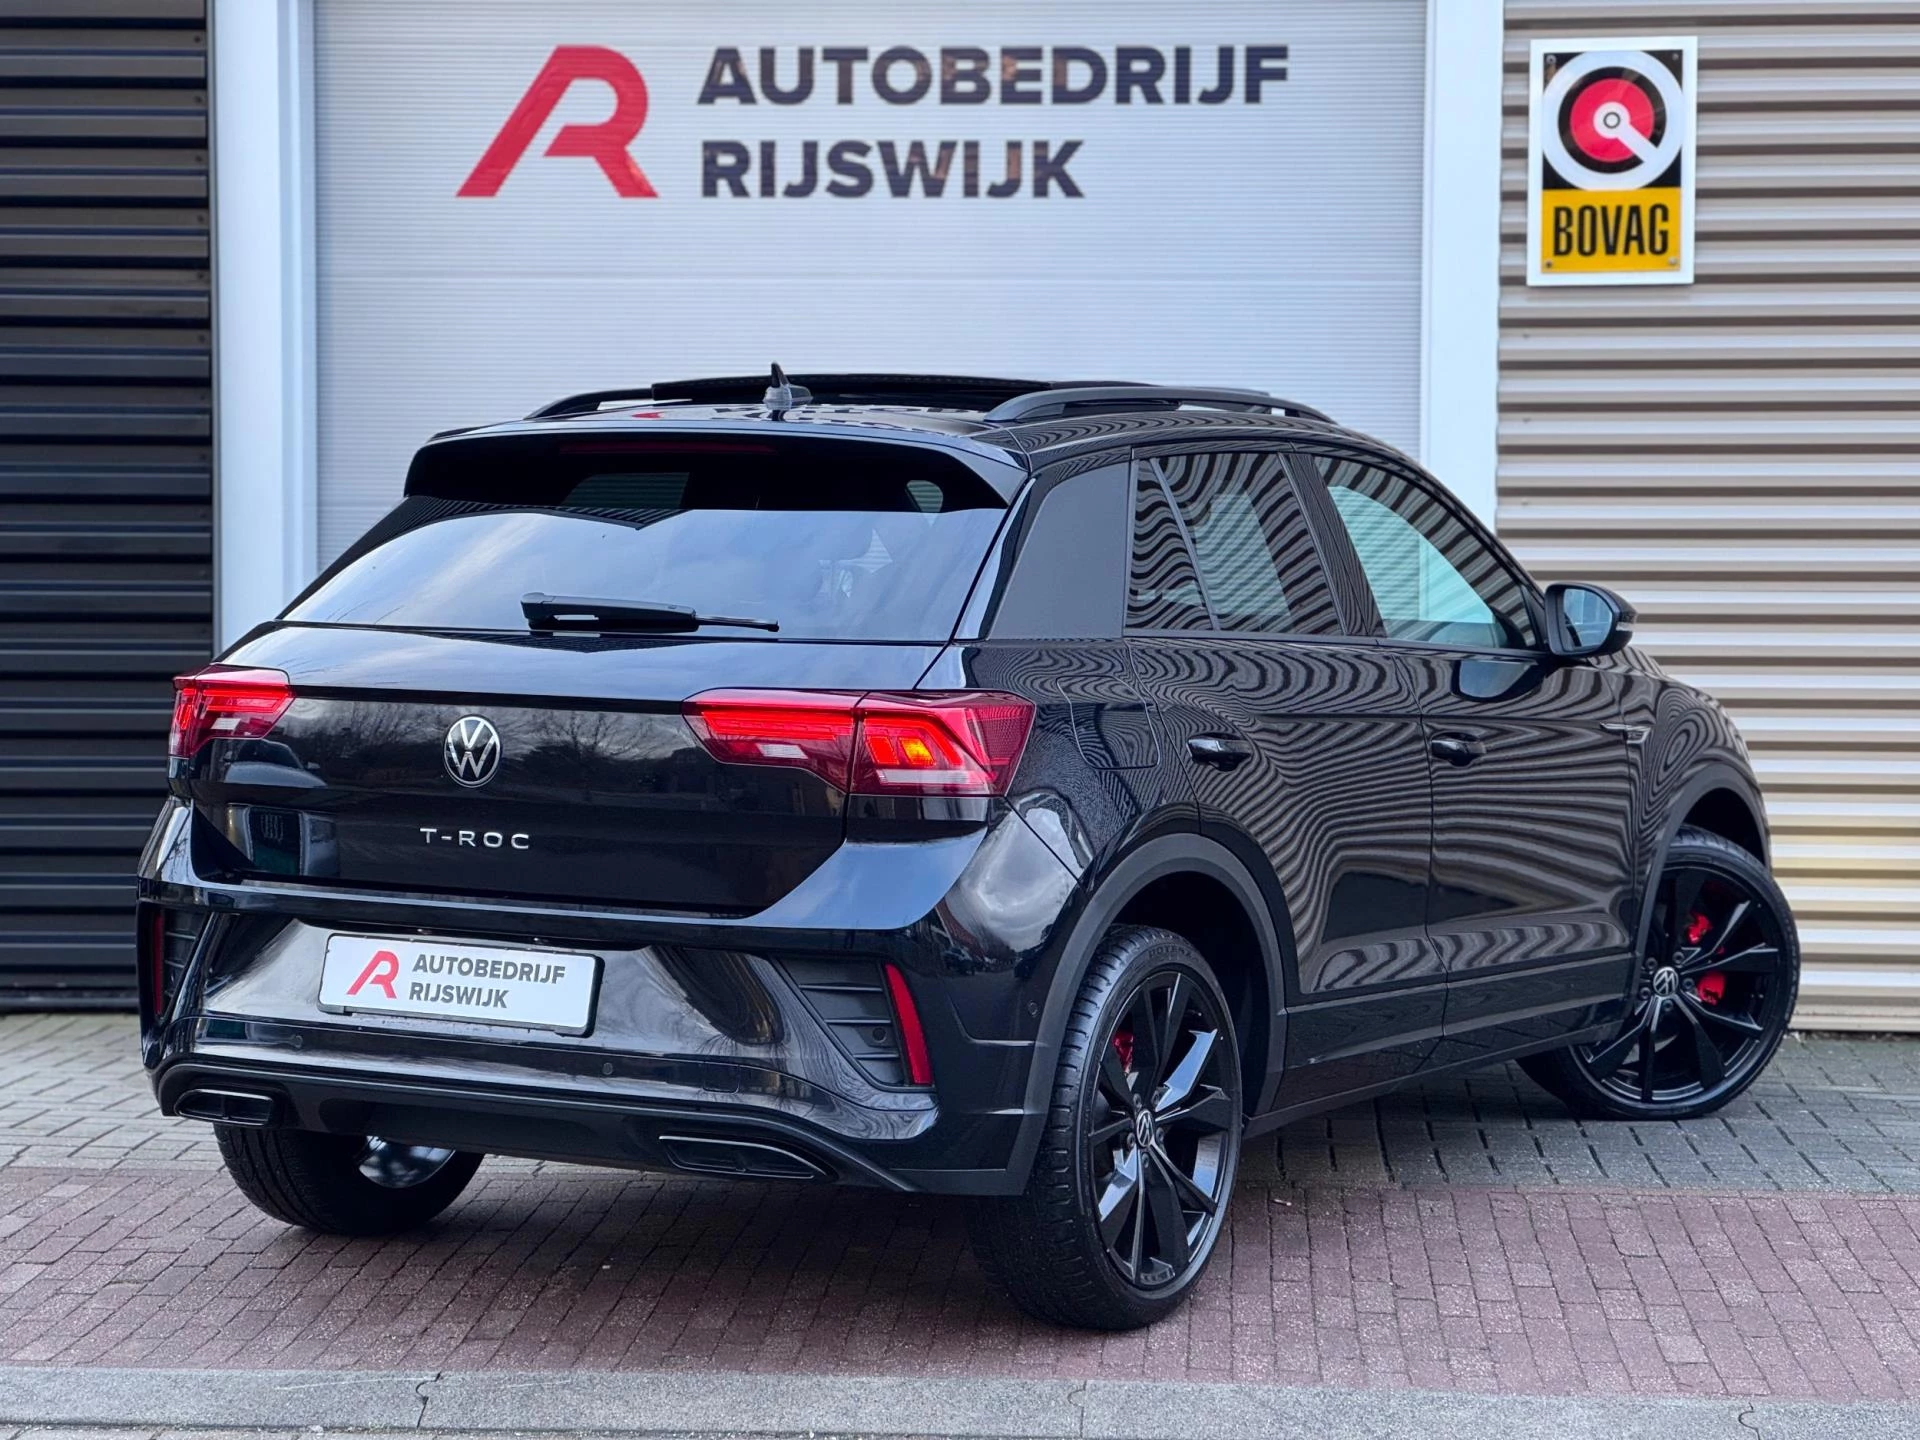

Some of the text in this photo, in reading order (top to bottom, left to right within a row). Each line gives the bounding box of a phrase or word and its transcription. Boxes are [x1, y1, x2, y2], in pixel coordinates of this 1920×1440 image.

[698, 45, 1290, 106] AUTOBEDRIJF
[702, 140, 1085, 199] RIJSWIJK
[1553, 204, 1670, 257] BOVAG
[419, 827, 530, 850] T-ROC
[412, 953, 566, 984] AUTOBEDRIJF
[409, 981, 509, 1009] RIJSWIJK
